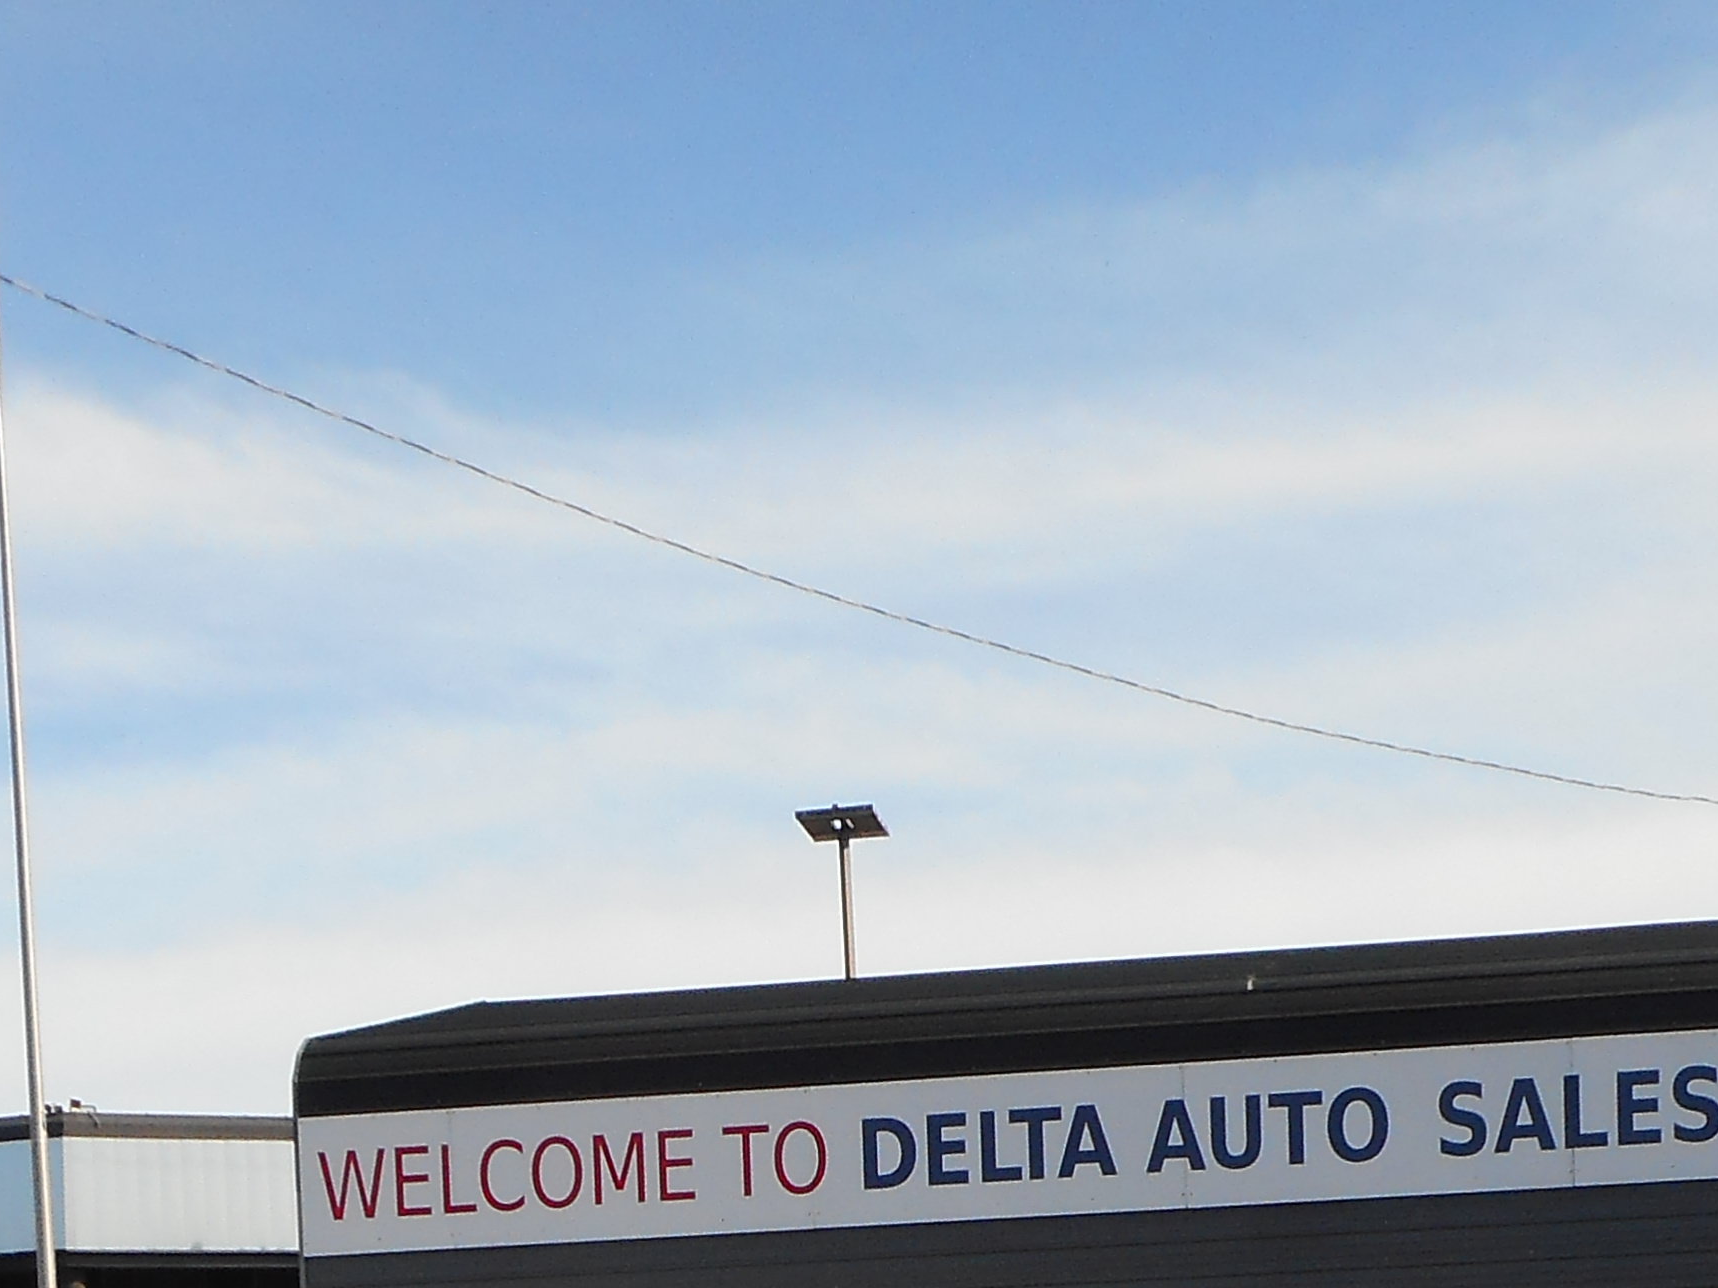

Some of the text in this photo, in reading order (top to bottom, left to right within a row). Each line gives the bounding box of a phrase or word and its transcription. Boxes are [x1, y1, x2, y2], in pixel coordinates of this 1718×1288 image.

[320, 1127, 699, 1220] WELCOME
[722, 1121, 828, 1195] TO
[862, 1103, 1118, 1185] DELTA
[1146, 1086, 1390, 1168] AUTO
